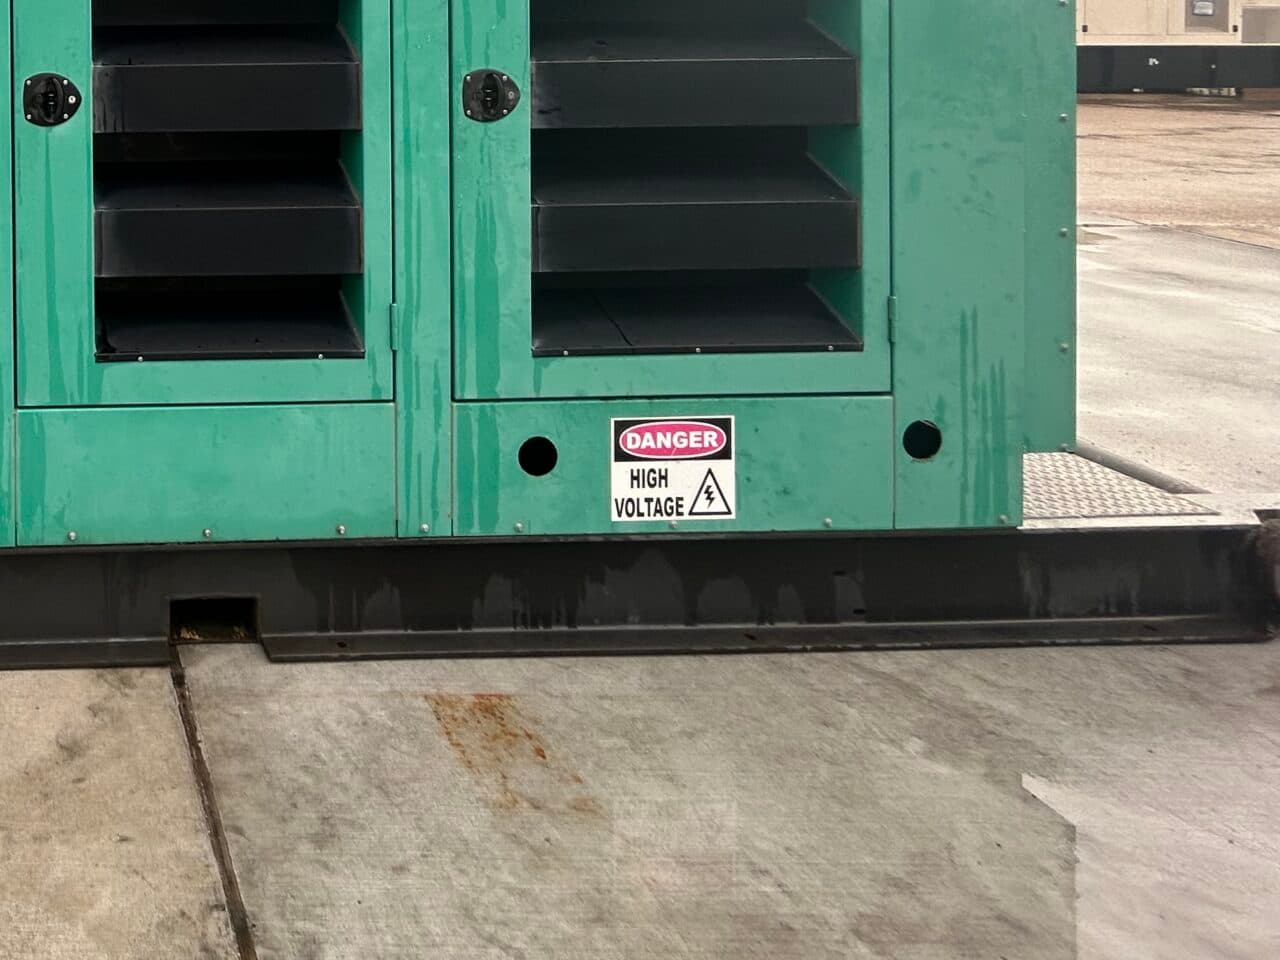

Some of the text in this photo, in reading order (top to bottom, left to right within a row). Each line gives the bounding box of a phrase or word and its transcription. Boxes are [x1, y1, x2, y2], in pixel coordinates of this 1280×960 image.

[625, 430, 719, 450] DANGER
[630, 468, 669, 489] HIGH
[615, 496, 685, 518] VOLTAGE
